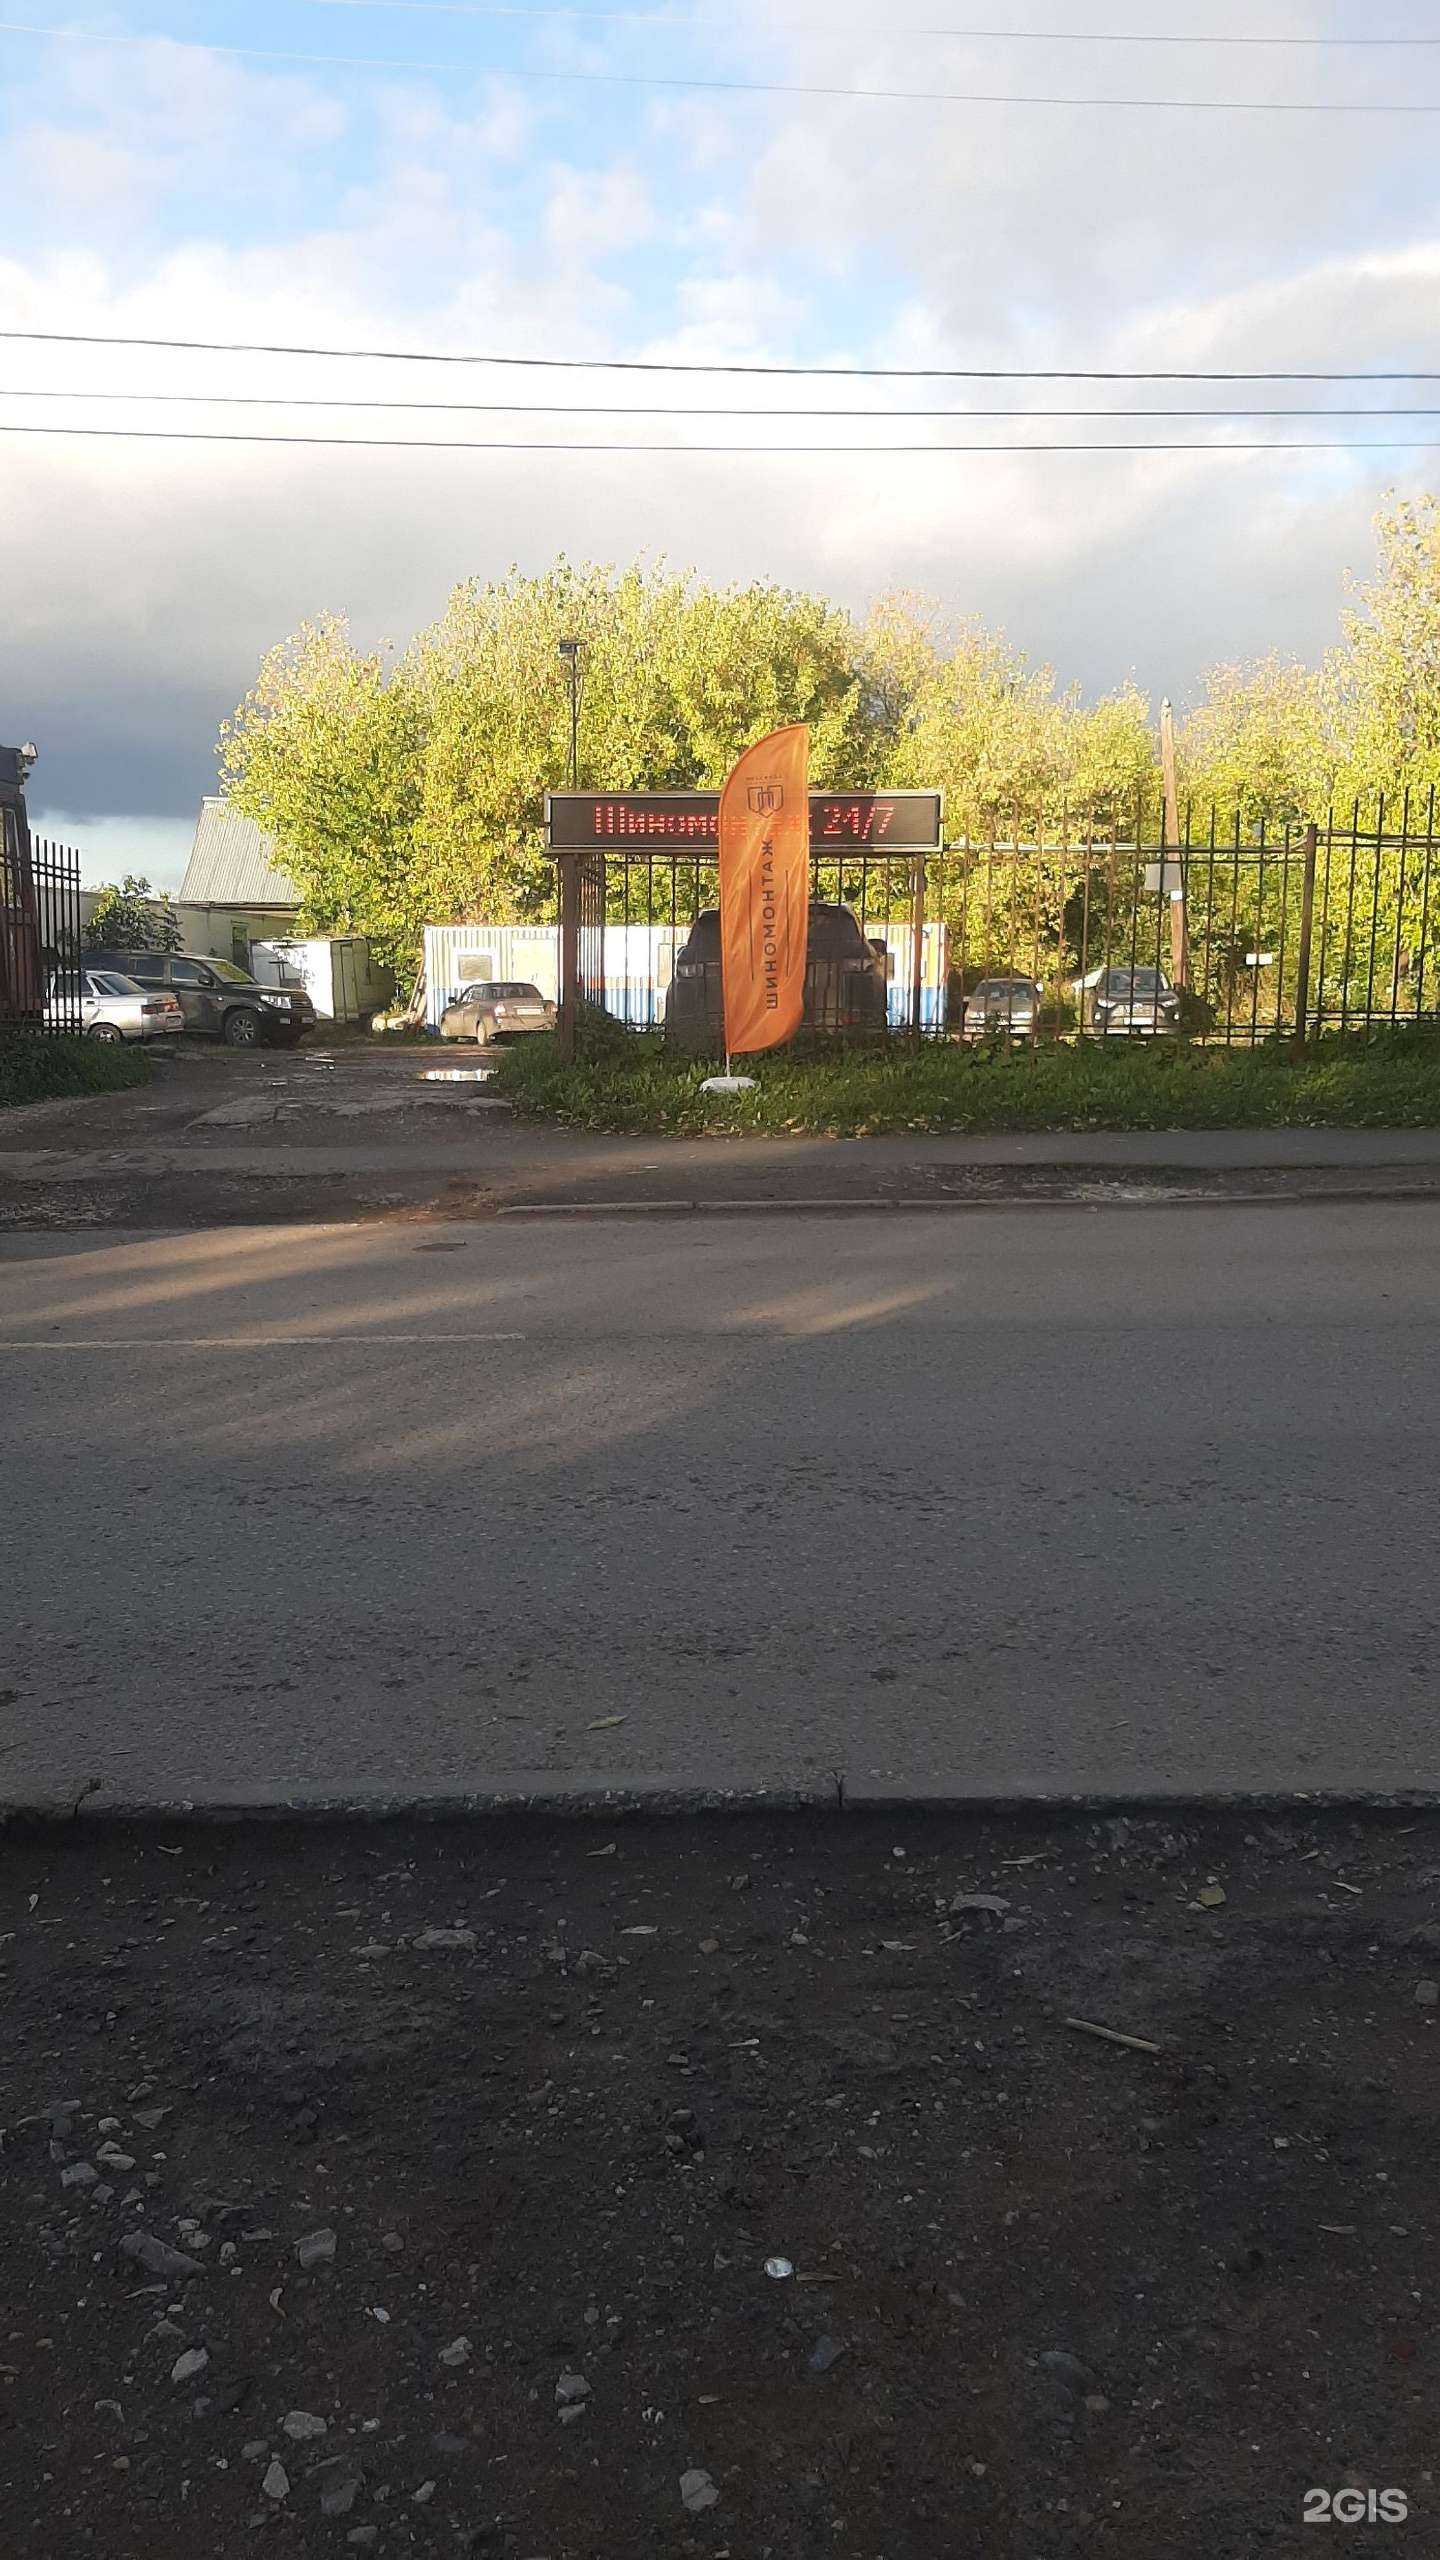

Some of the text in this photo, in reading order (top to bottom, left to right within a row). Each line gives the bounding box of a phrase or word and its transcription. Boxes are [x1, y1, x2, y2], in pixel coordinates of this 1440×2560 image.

[594, 806, 894, 839] Шиномо 24/7
[761, 839, 778, 1010] ШИНОМОНТАЖ
